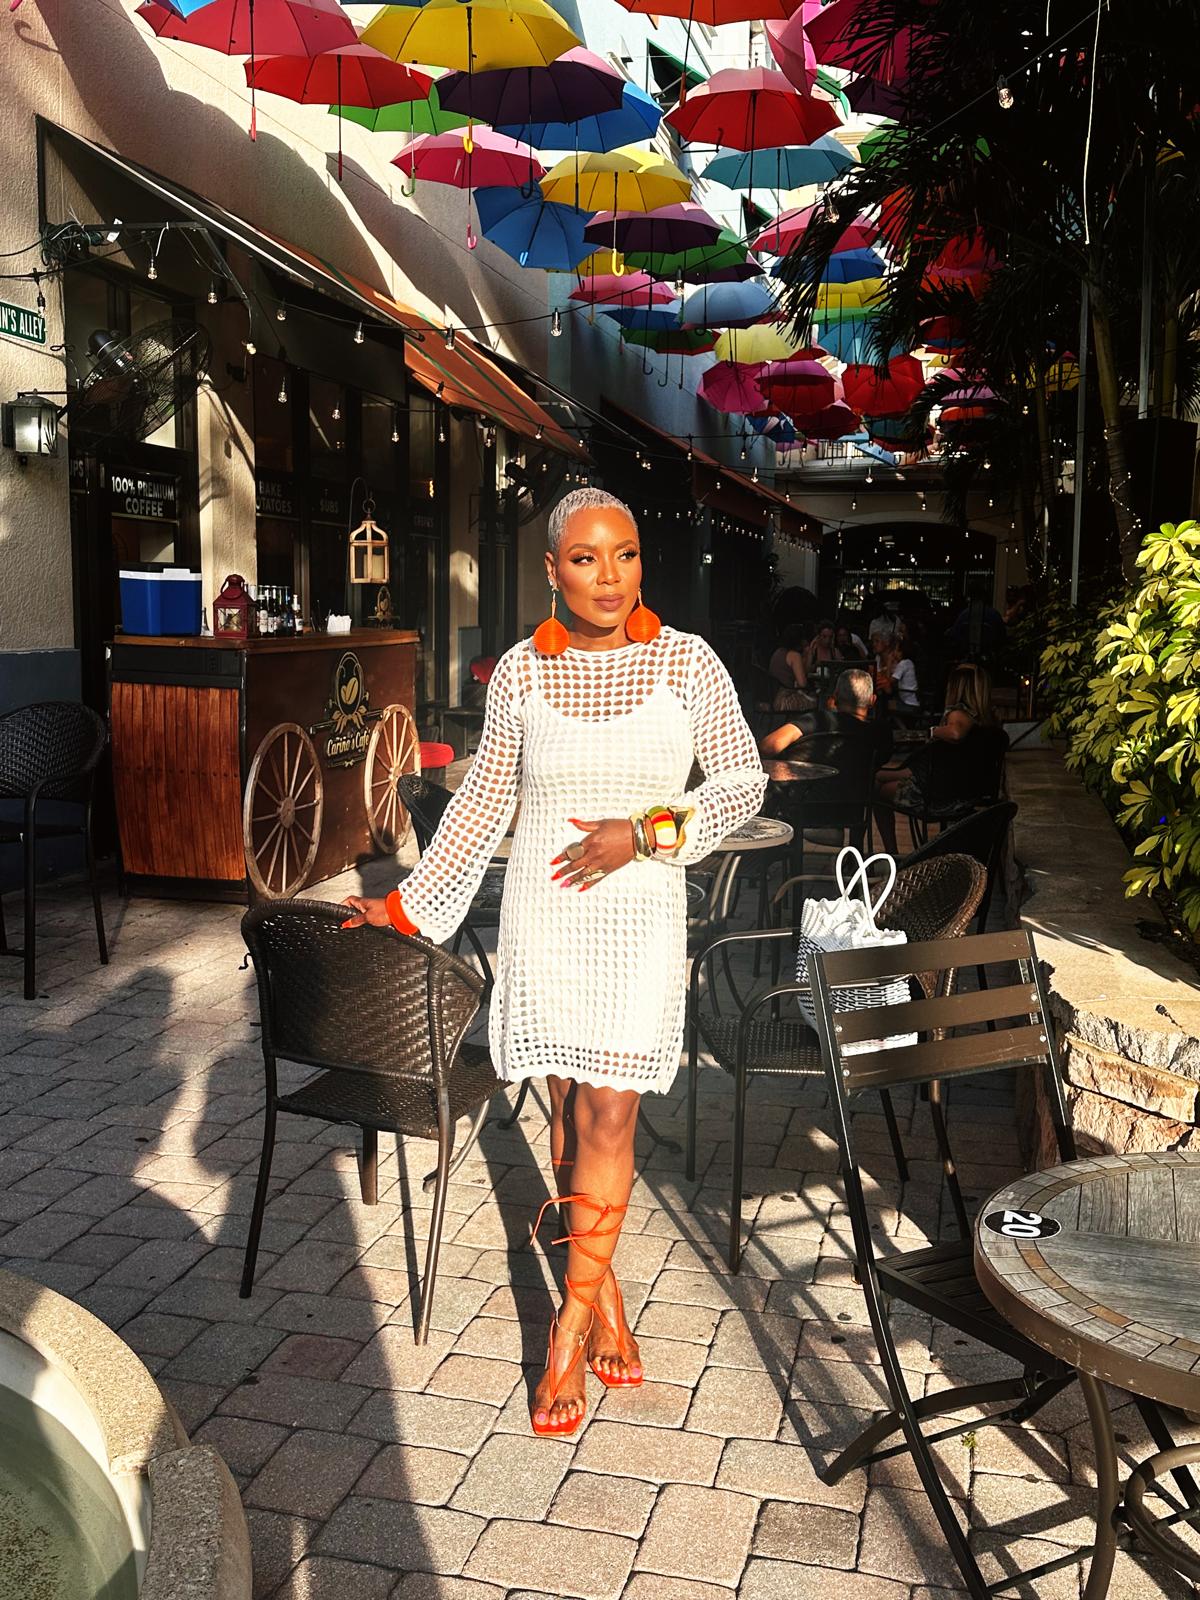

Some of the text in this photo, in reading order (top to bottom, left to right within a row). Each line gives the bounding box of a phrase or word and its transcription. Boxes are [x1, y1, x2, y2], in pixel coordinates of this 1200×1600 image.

[0, 305, 43, 340] N'S ALLEY
[112, 476, 174, 501] 100% PREMIUM
[125, 497, 164, 517] COFFEE
[1001, 1210, 1043, 1238] 20
